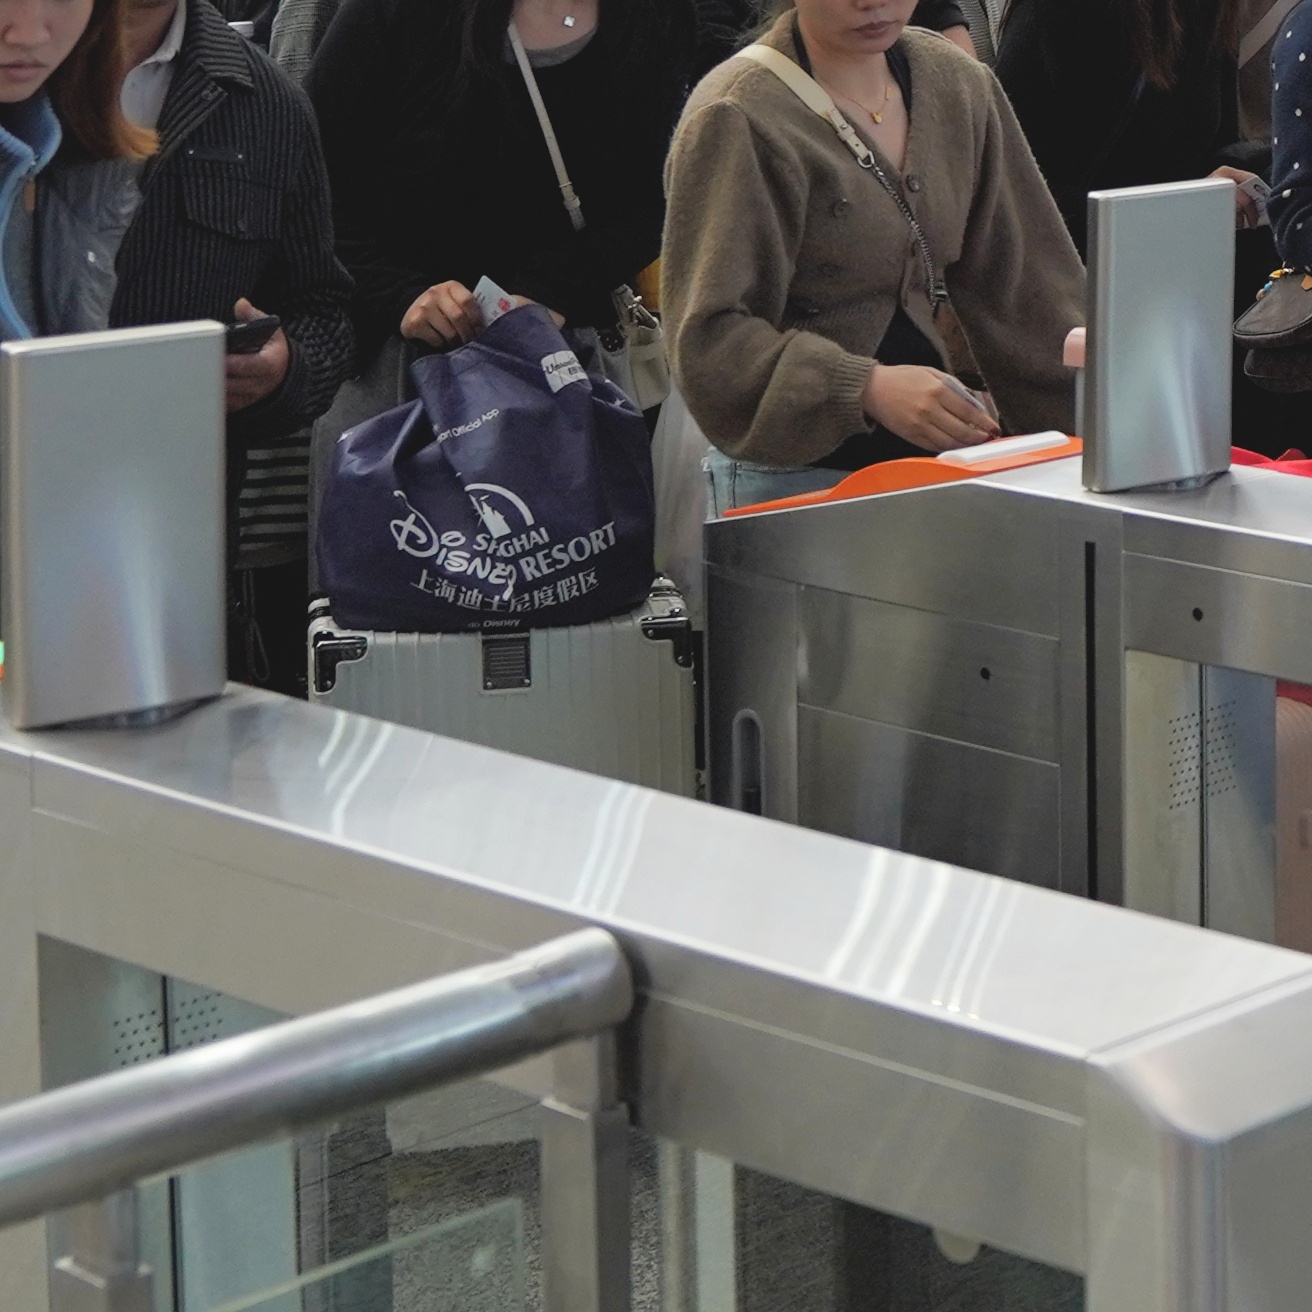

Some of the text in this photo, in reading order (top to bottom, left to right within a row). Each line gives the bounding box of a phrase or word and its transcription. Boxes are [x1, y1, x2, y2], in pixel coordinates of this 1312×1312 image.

[450, 417, 483, 439] Official
[480, 406, 500, 425] App
[521, 520, 618, 582] RESORT
[409, 566, 601, 614] 上海迪士尼度假区
